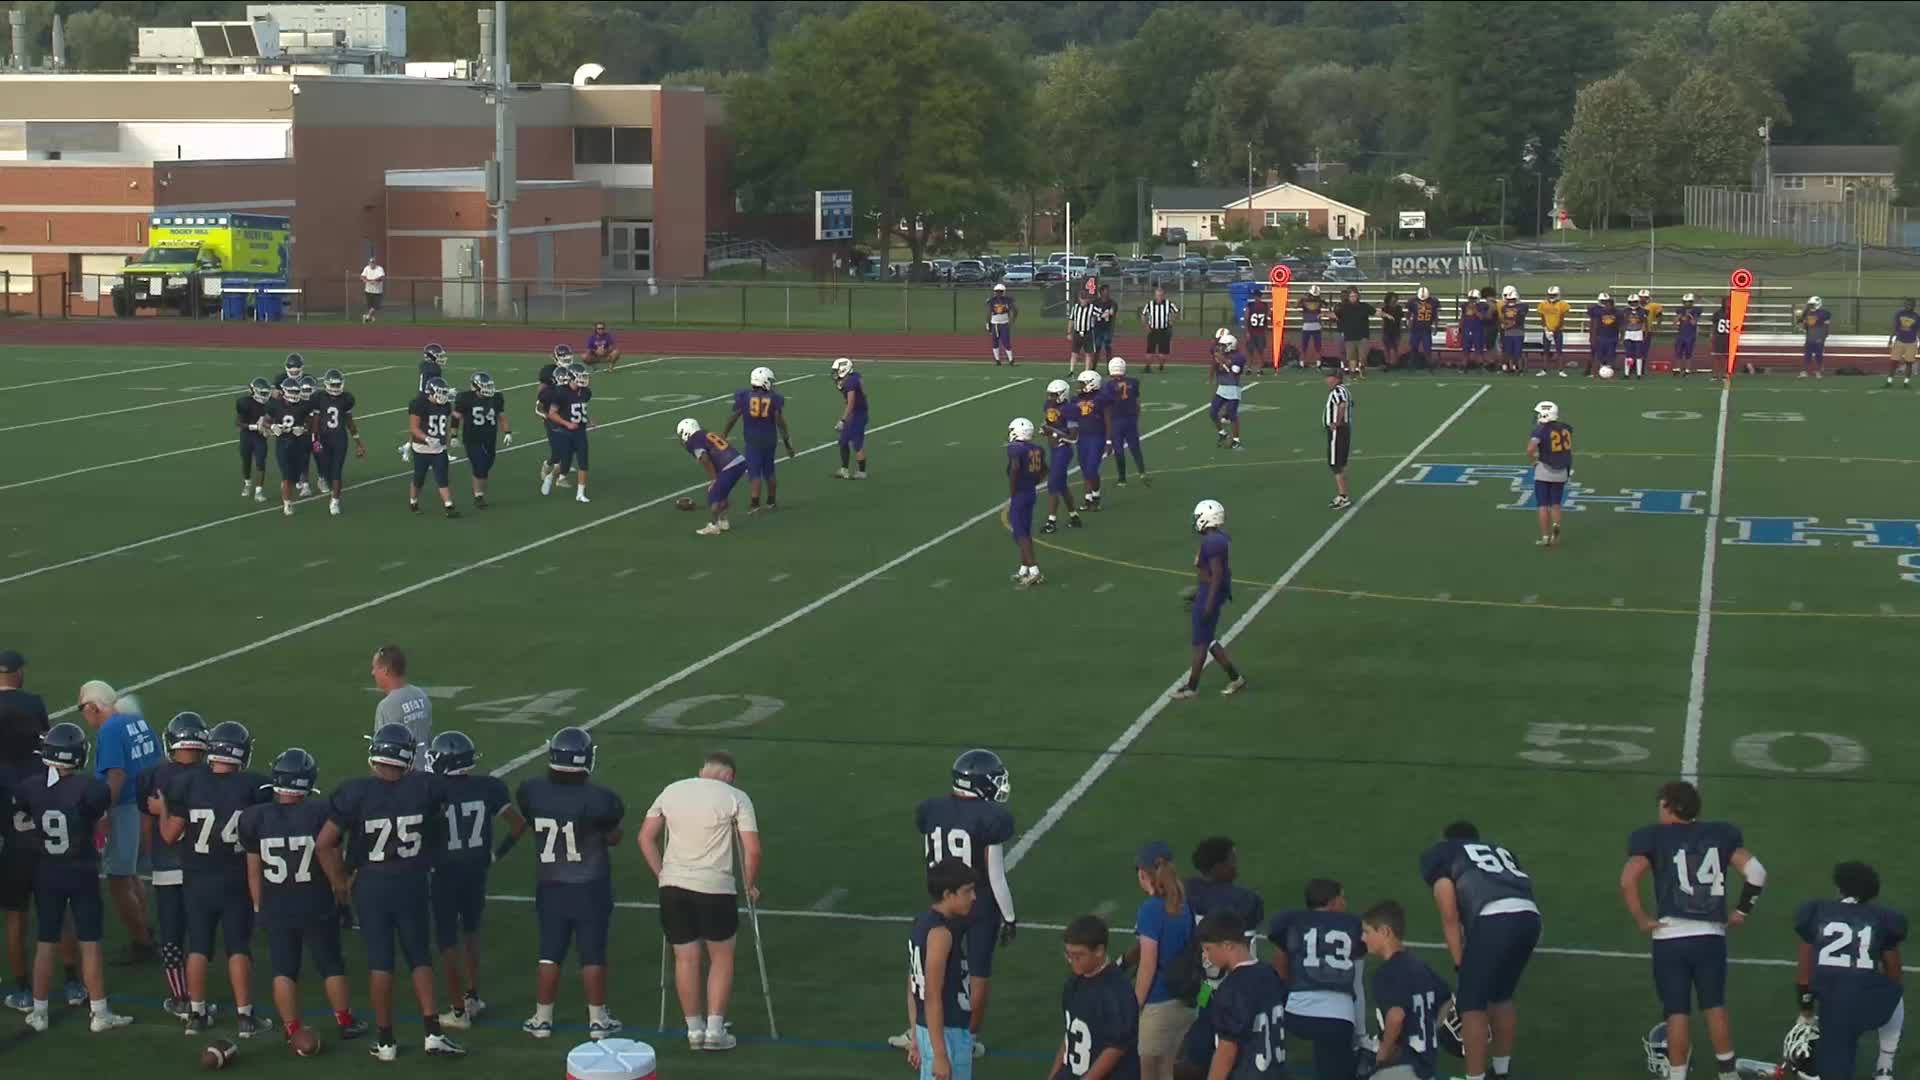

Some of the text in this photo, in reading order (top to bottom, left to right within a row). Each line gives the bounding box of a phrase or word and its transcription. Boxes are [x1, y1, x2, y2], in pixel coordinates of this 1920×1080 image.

[1086, 277, 1096, 295] 4
[1391, 256, 1500, 276] ROCKY HIL
[1250, 312, 1265, 327] 67
[326, 407, 339, 429] 3
[472, 407, 496, 426] 54
[750, 397, 771, 418] 97
[1550, 430, 1572, 452] 23
[41, 809, 70, 854] 9
[189, 808, 242, 854] 74
[365, 815, 424, 862] 75
[445, 800, 486, 850] 17
[534, 817, 583, 863] 71
[260, 835, 316, 884] 57
[929, 826, 972, 868] 19
[1673, 847, 1725, 897] 14
[1302, 927, 1353, 970] 13
[1818, 921, 1874, 970] 21
